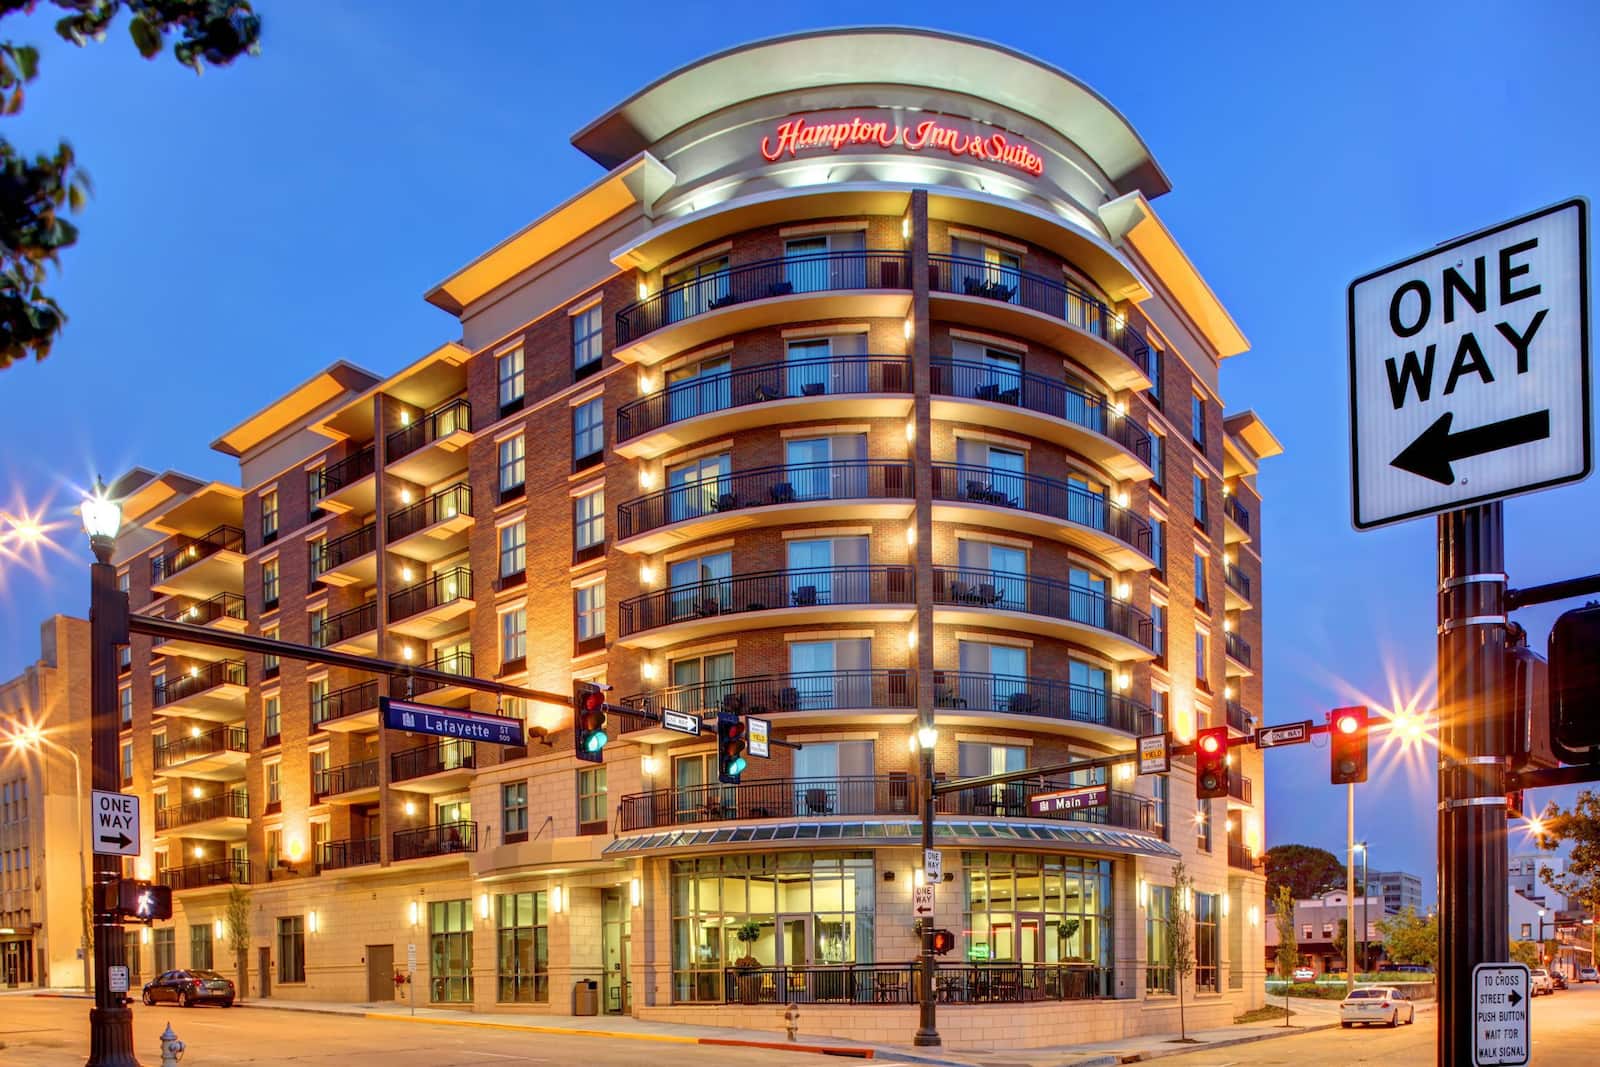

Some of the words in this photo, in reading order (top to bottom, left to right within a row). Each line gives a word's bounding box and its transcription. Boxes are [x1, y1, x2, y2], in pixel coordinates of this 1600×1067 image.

[762, 117, 898, 160] Hampton
[903, 121, 969, 154] Inn
[1389, 237, 1542, 338] ONE
[1385, 308, 1549, 410] WAY
[425, 715, 490, 737] Lafayette
[1288, 729, 1301, 737] WAY
[100, 797, 132, 813] ONE
[1056, 798, 1081, 810] Main
[100, 814, 133, 829] WAY
[927, 852, 939, 861] ONE
[927, 861, 939, 869] WAY
[916, 887, 931, 895] ONE
[916, 896, 931, 904] WAY
[1484, 976, 1493, 986] TO
[1495, 976, 1519, 986] CROSS
[1480, 994, 1505, 1004] STREET
[1479, 1012, 1496, 1022] PUSH
[1499, 1011, 1525, 1021] BUTTON
[1485, 1029, 1501, 1040] WAIT
[1504, 1029, 1519, 1039] FOR
[1479, 1047, 1497, 1058] WALK
[1499, 1046, 1525, 1057] SIGNAL
